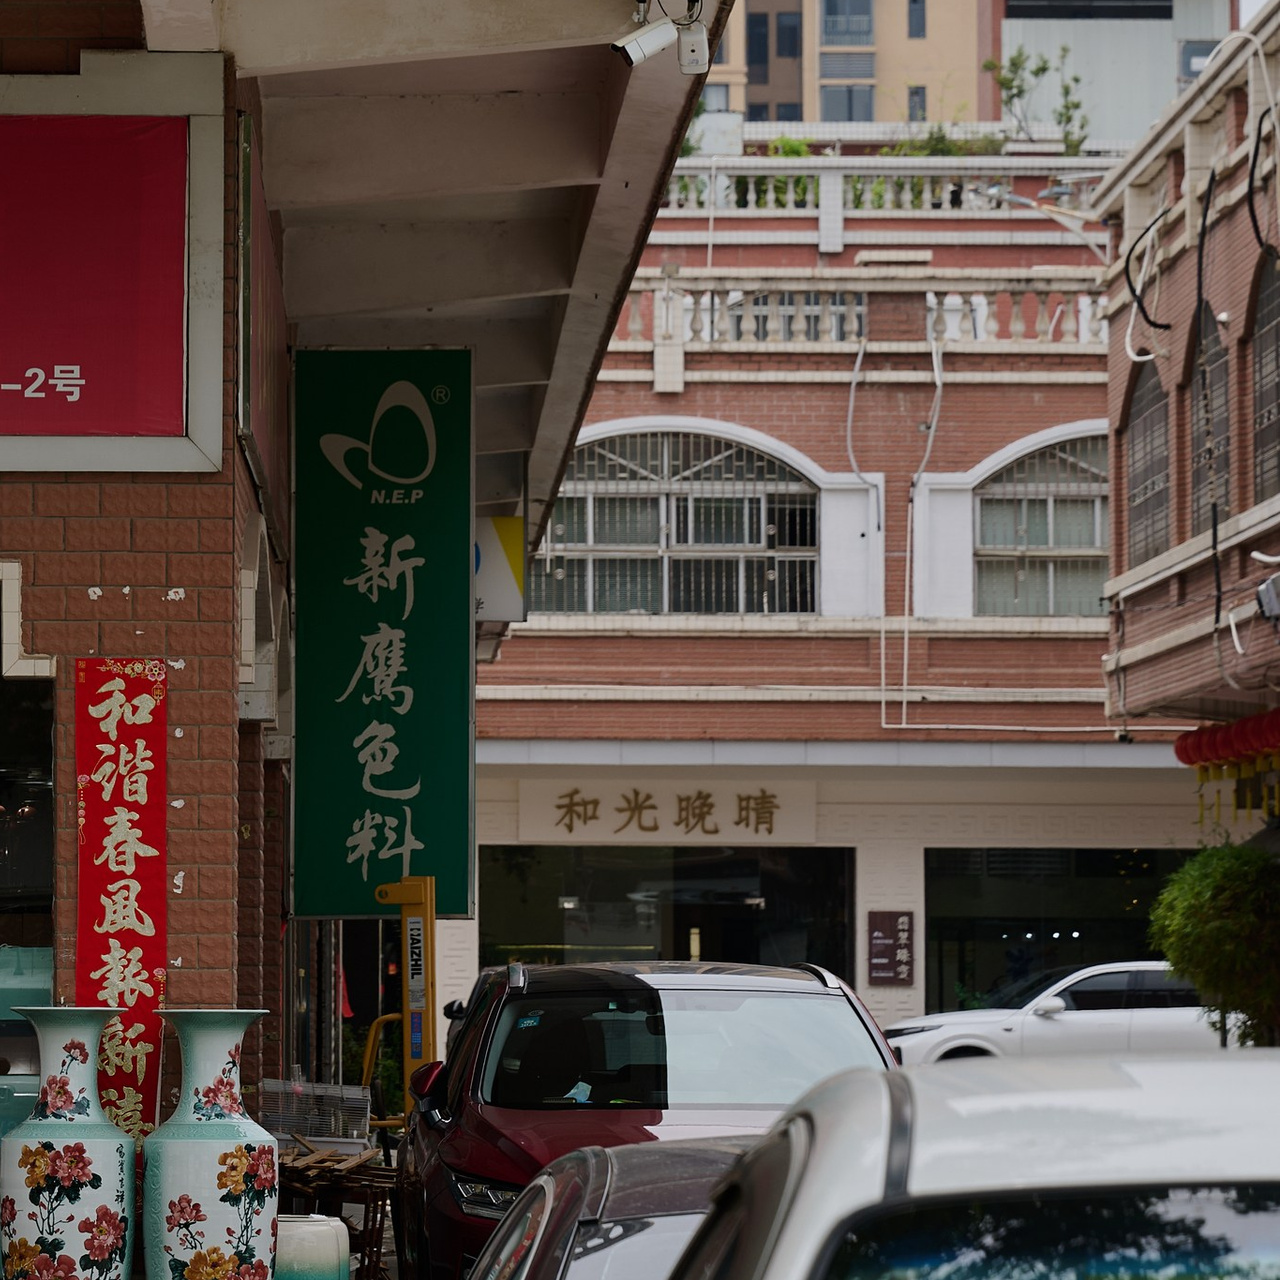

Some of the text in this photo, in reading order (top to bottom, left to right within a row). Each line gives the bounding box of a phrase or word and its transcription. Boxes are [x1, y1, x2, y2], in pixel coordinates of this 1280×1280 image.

[370, 489, 424, 504] N.E.P
[554, 787, 781, 836] 和光晚晴
